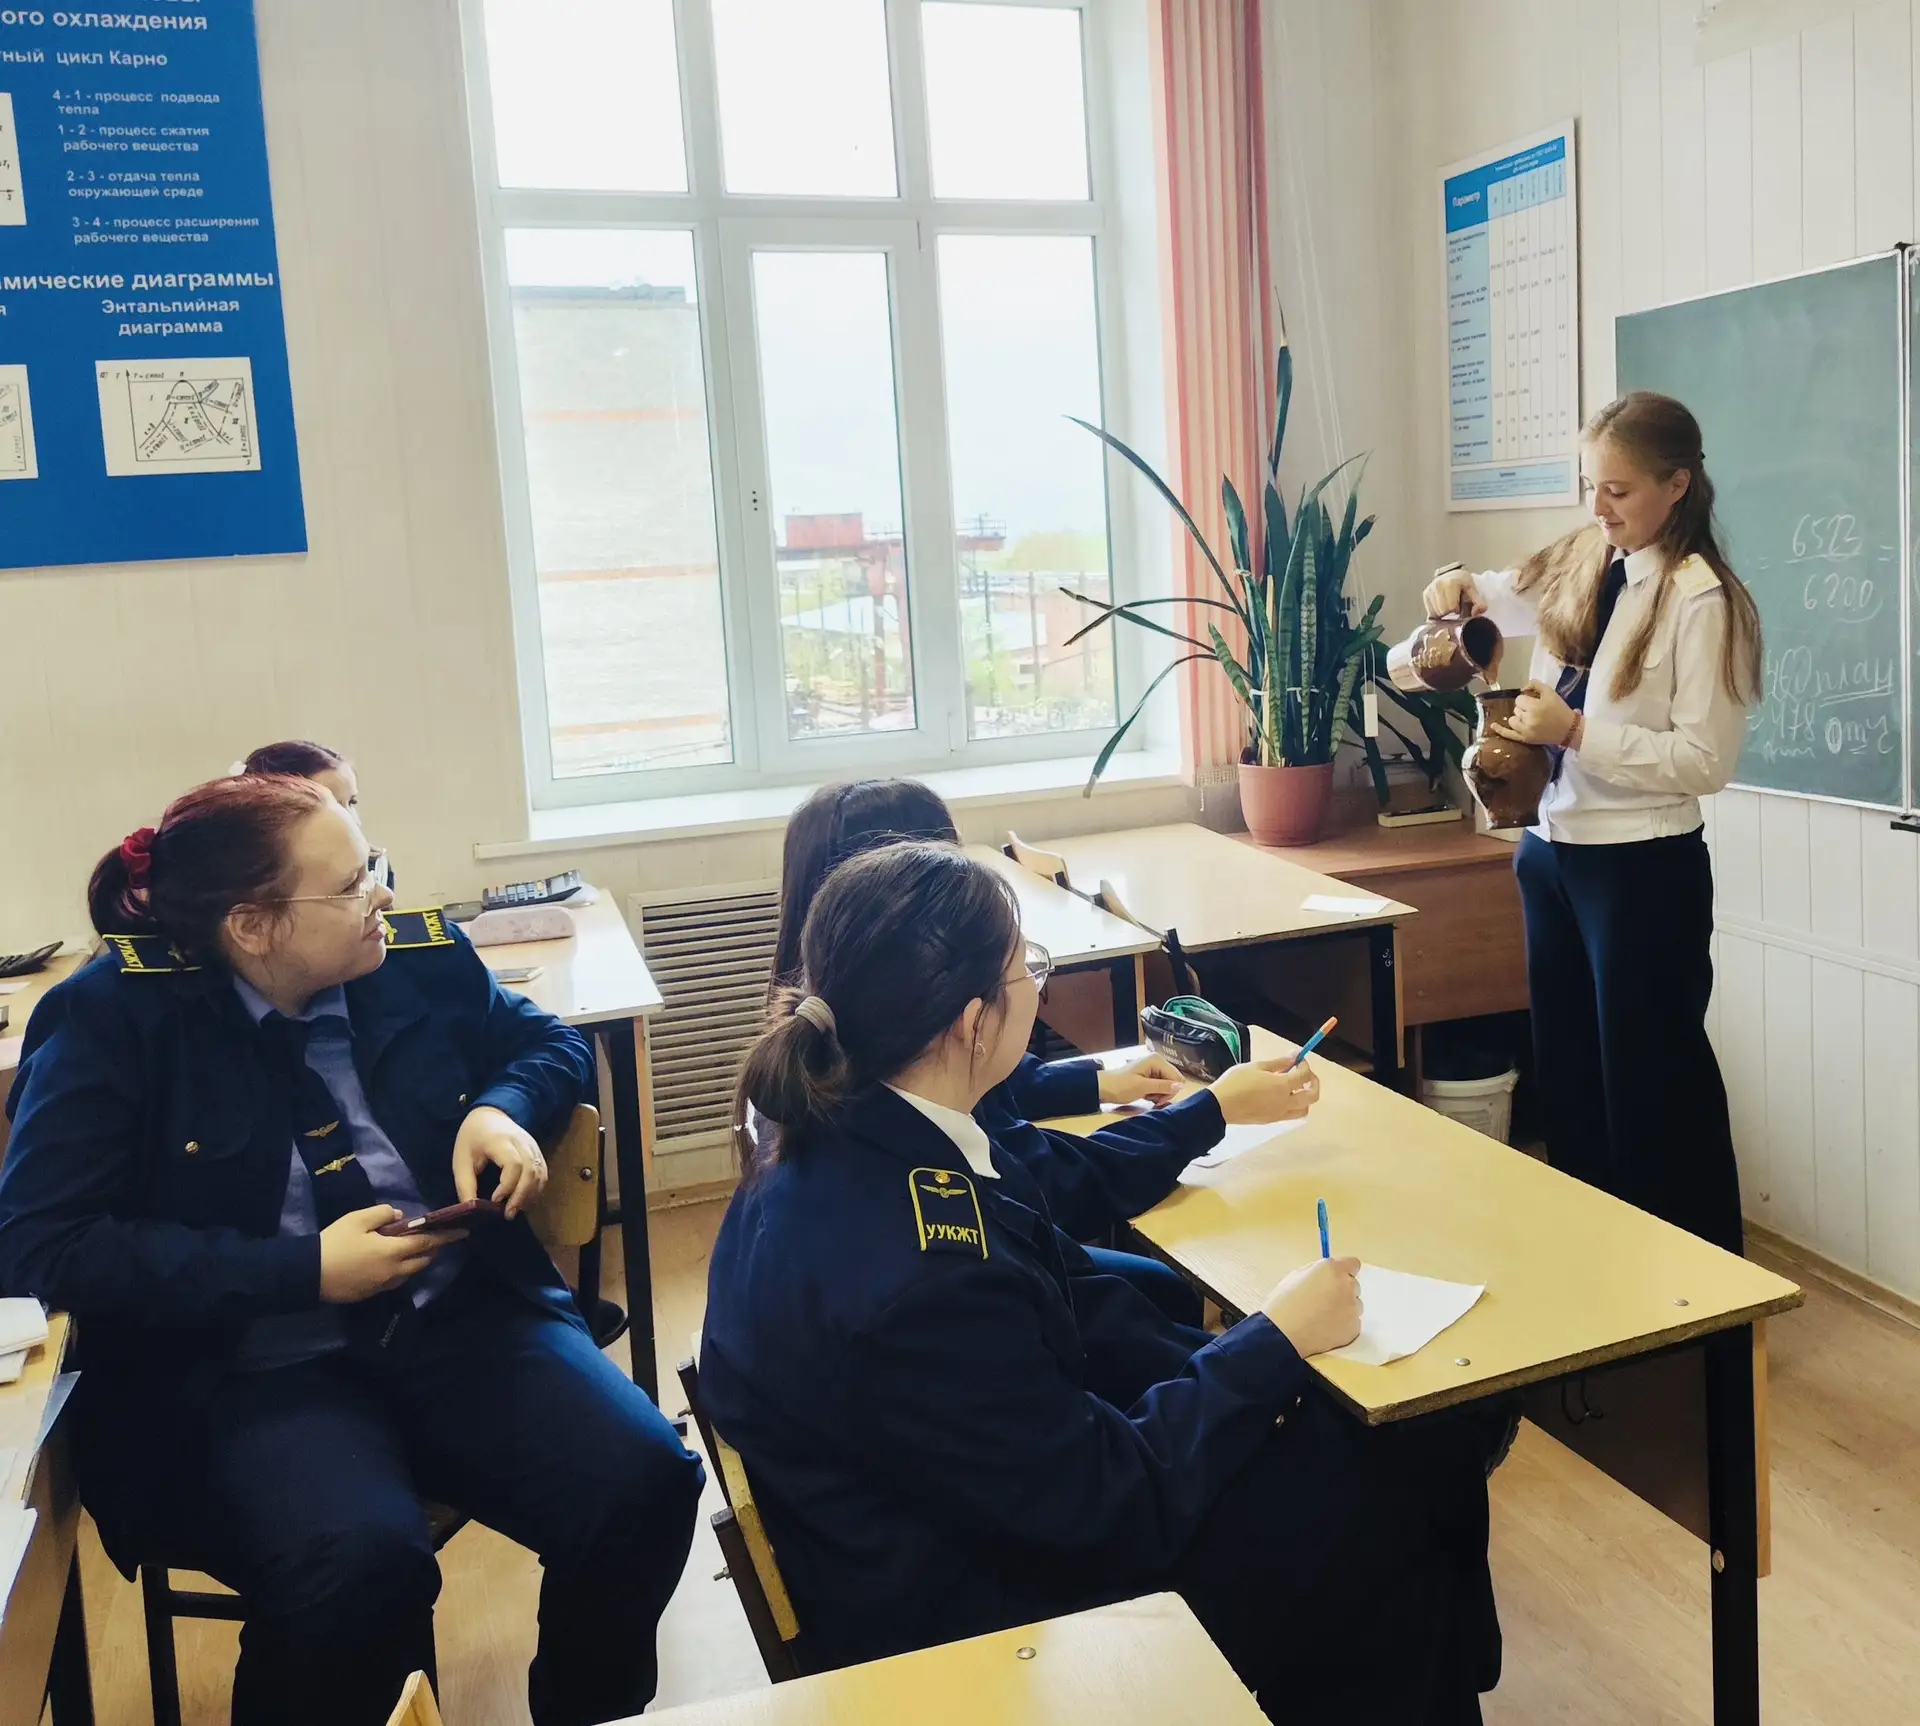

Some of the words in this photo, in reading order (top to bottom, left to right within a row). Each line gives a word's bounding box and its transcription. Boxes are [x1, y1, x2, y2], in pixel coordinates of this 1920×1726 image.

[52, 11, 208, 32] охлаждения
[56, 51, 104, 66] цикл
[109, 50, 168, 69] Карно
[52, 89, 61, 101] 4
[74, 89, 81, 101] 1
[94, 92, 153, 104] процесс
[160, 93, 221, 104] подвода
[57, 105, 100, 116] тепла
[57, 123, 64, 135] 1
[77, 123, 86, 136] 2
[98, 126, 157, 138] процесс
[160, 127, 210, 137] сжатия
[63, 139, 129, 153] рабочего
[131, 142, 199, 153] вещества
[66, 169, 75, 182] 2
[87, 170, 96, 182] 3
[107, 172, 157, 183] отдача
[159, 172, 201, 182] тепла
[68, 186, 160, 200] окружающей
[162, 187, 204, 199] среде
[72, 216, 81, 228] 3
[92, 216, 101, 228] 4
[113, 218, 172, 230] процесс
[174, 217, 260, 229] расширения
[73, 231, 139, 246] рабочего
[142, 232, 209, 244] вещества
[0, 274, 125, 290] мические
[131, 272, 274, 292] диаграммы
[101, 298, 240, 314] Энтальпийная
[118, 321, 224, 337] диаграмма
[925, 1223, 979, 1245] УУКЖТ
